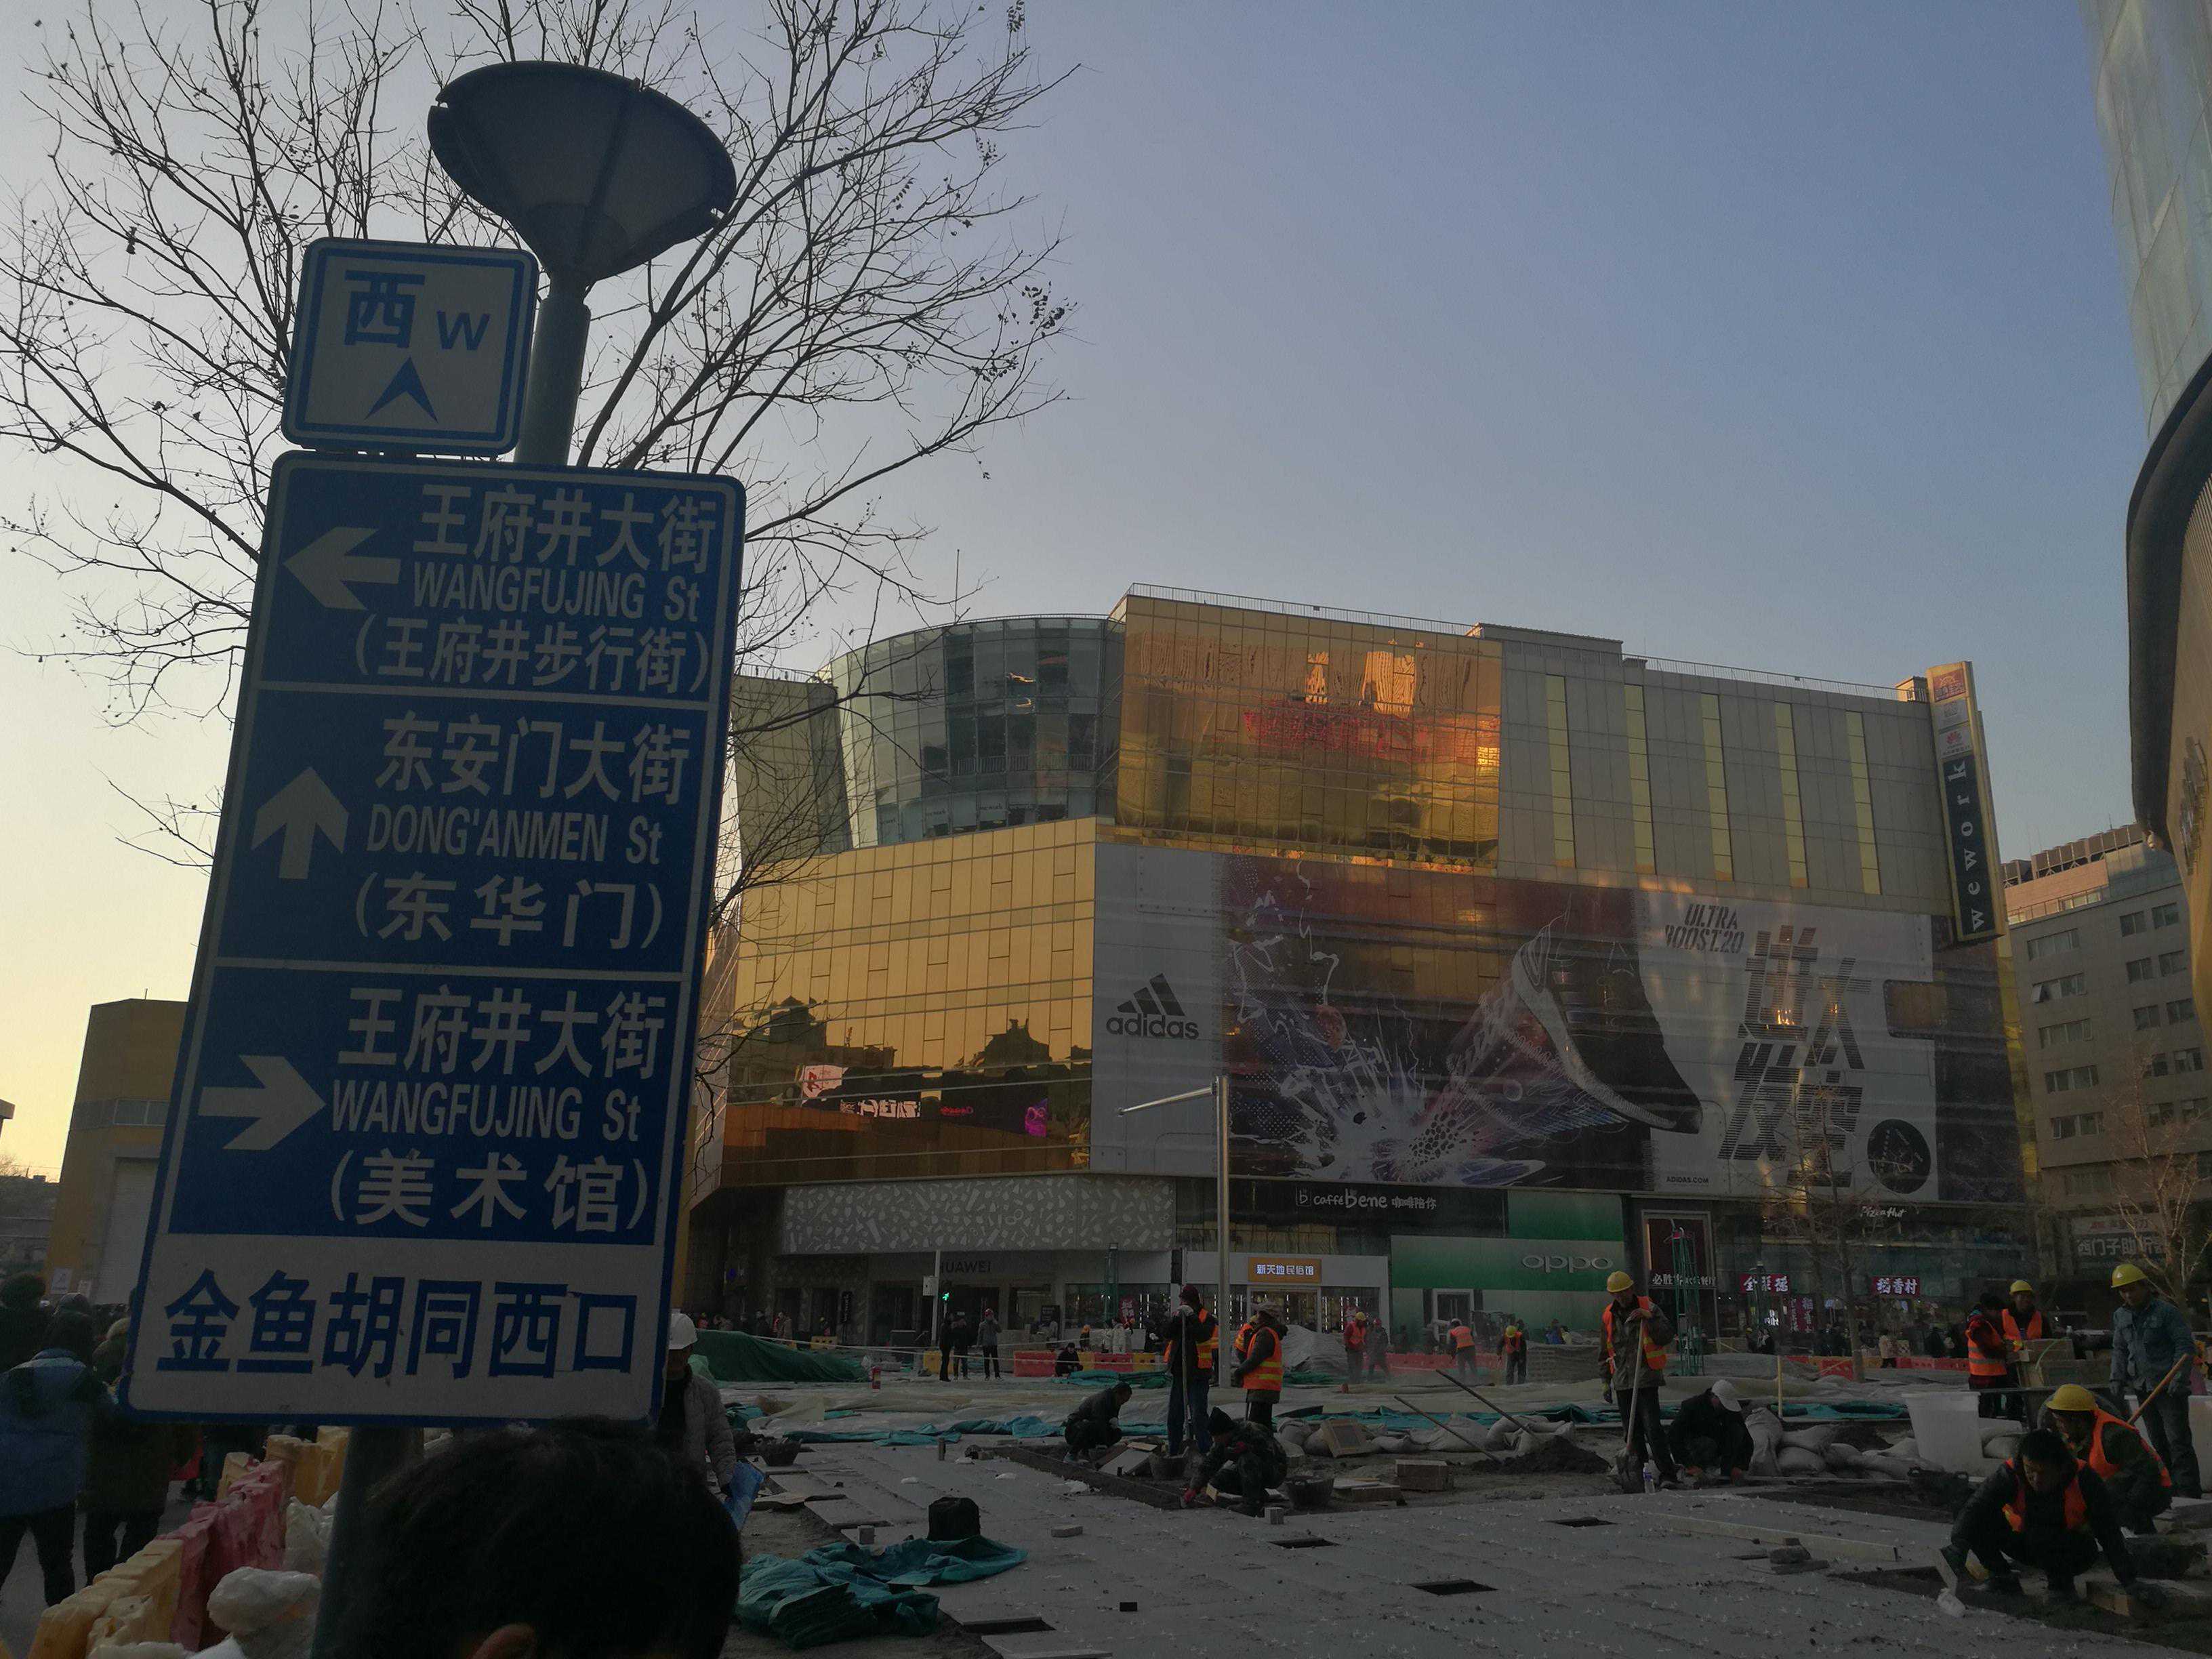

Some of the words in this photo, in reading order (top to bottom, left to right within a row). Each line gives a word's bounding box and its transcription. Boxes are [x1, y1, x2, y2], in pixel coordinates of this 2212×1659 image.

[344, 270, 426, 348] 西
[436, 310, 491, 351] W
[413, 483, 717, 574] 王府井大街
[413, 561, 646, 619] WANGFUJING
[663, 575, 699, 623] St
[355, 613, 710, 693] (王府井步行街)
[375, 710, 690, 806] 东安门大街
[367, 804, 609, 863] DONG'ANMEN
[626, 815, 663, 865] St
[1948, 760, 1985, 931] wework
[356, 872, 663, 949] (东华门)
[1684, 904, 1738, 929] ULTRA
[337, 984, 665, 1080] 王府井大街
[1106, 1012, 1200, 1040] adidas
[332, 1079, 583, 1140] WANGFUJING
[602, 1088, 641, 1142] St
[329, 1148, 649, 1233] (美术馆)
[1666, 1176, 1709, 1184] ADIDAS.COM
[1256, 1264, 1314, 1275] 新天地民俗馆
[1876, 1277, 1918, 1294] 稻香村
[156, 1267, 638, 1379] 金鱼胡同西口
